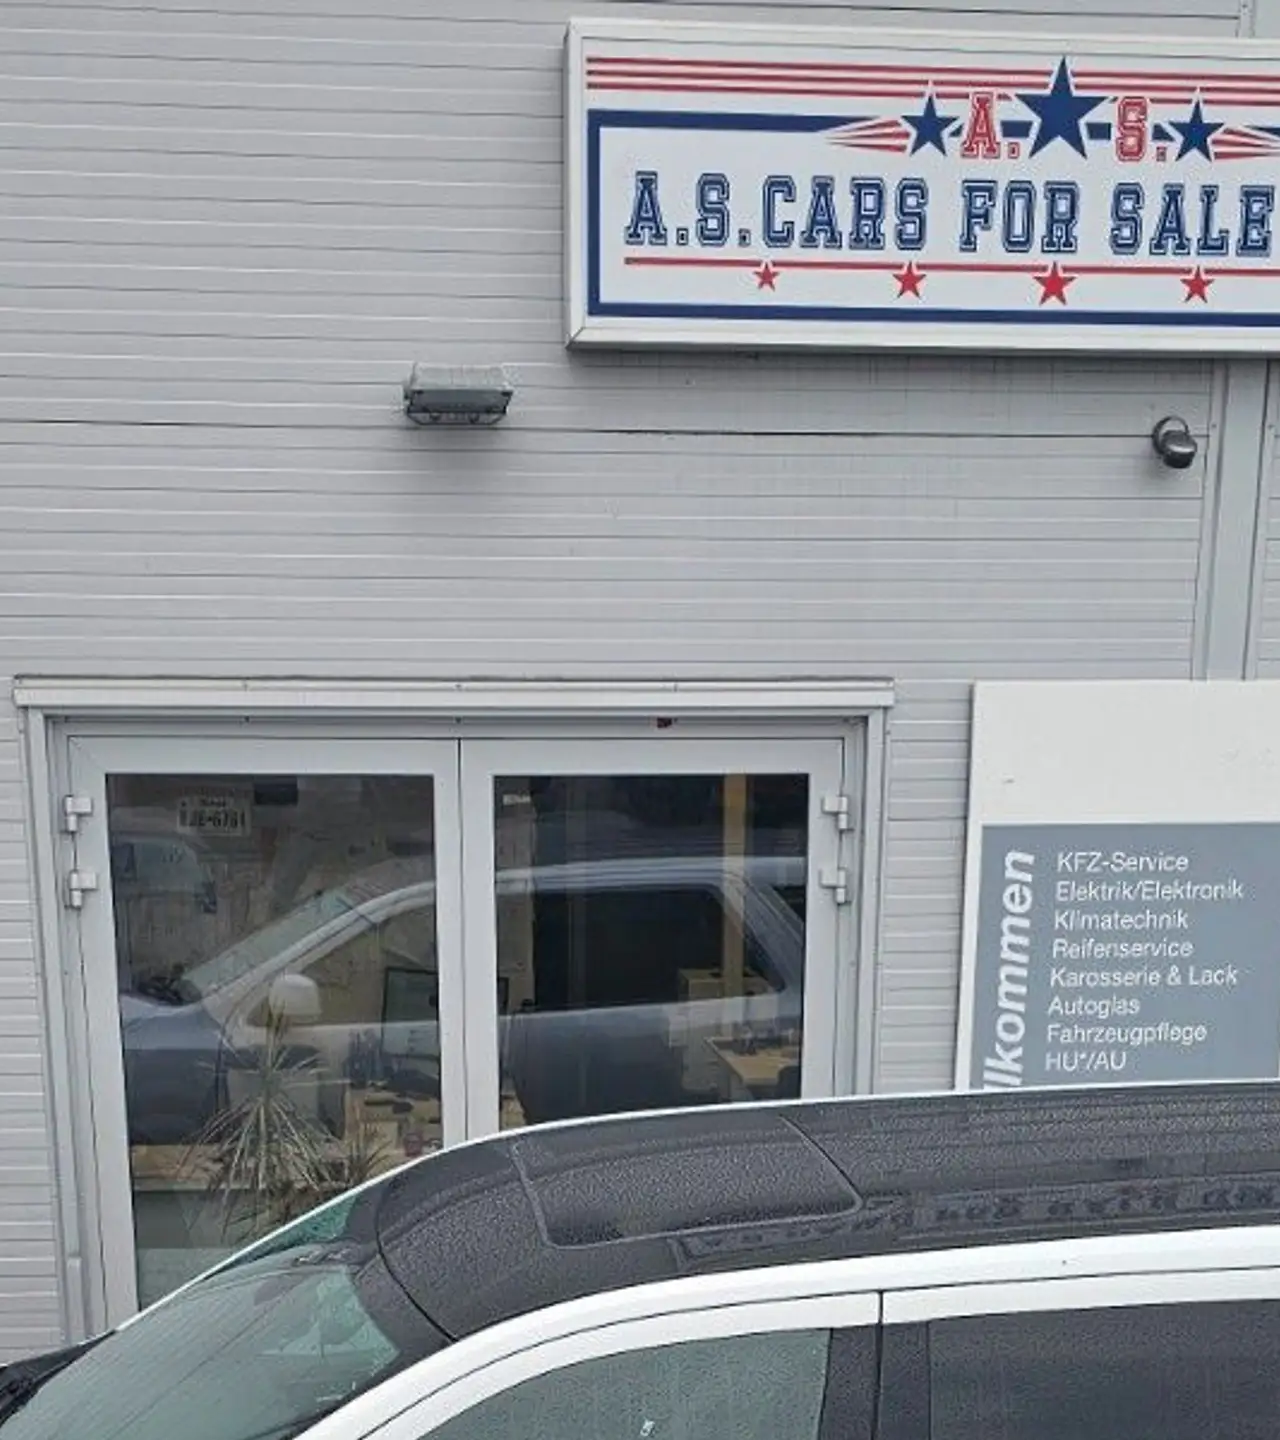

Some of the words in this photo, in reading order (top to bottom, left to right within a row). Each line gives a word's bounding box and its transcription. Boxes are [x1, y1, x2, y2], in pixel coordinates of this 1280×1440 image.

[959, 178, 1079, 254] FOR
[1109, 182, 1276, 257] SALE
[1056, 851, 1189, 873] KFZ-Service
[1055, 879, 1245, 901] Elektrik/Elektronik
[1054, 908, 1189, 931] Klimatechnik
[1052, 937, 1194, 959] Reifenservice
[1049, 965, 1161, 988] Karosserie
[1166, 964, 1182, 986] &
[1188, 964, 1238, 986] Lack
[1047, 994, 1141, 1019] Autoglas
[1046, 1021, 1208, 1046] Fahrzeugpflege
